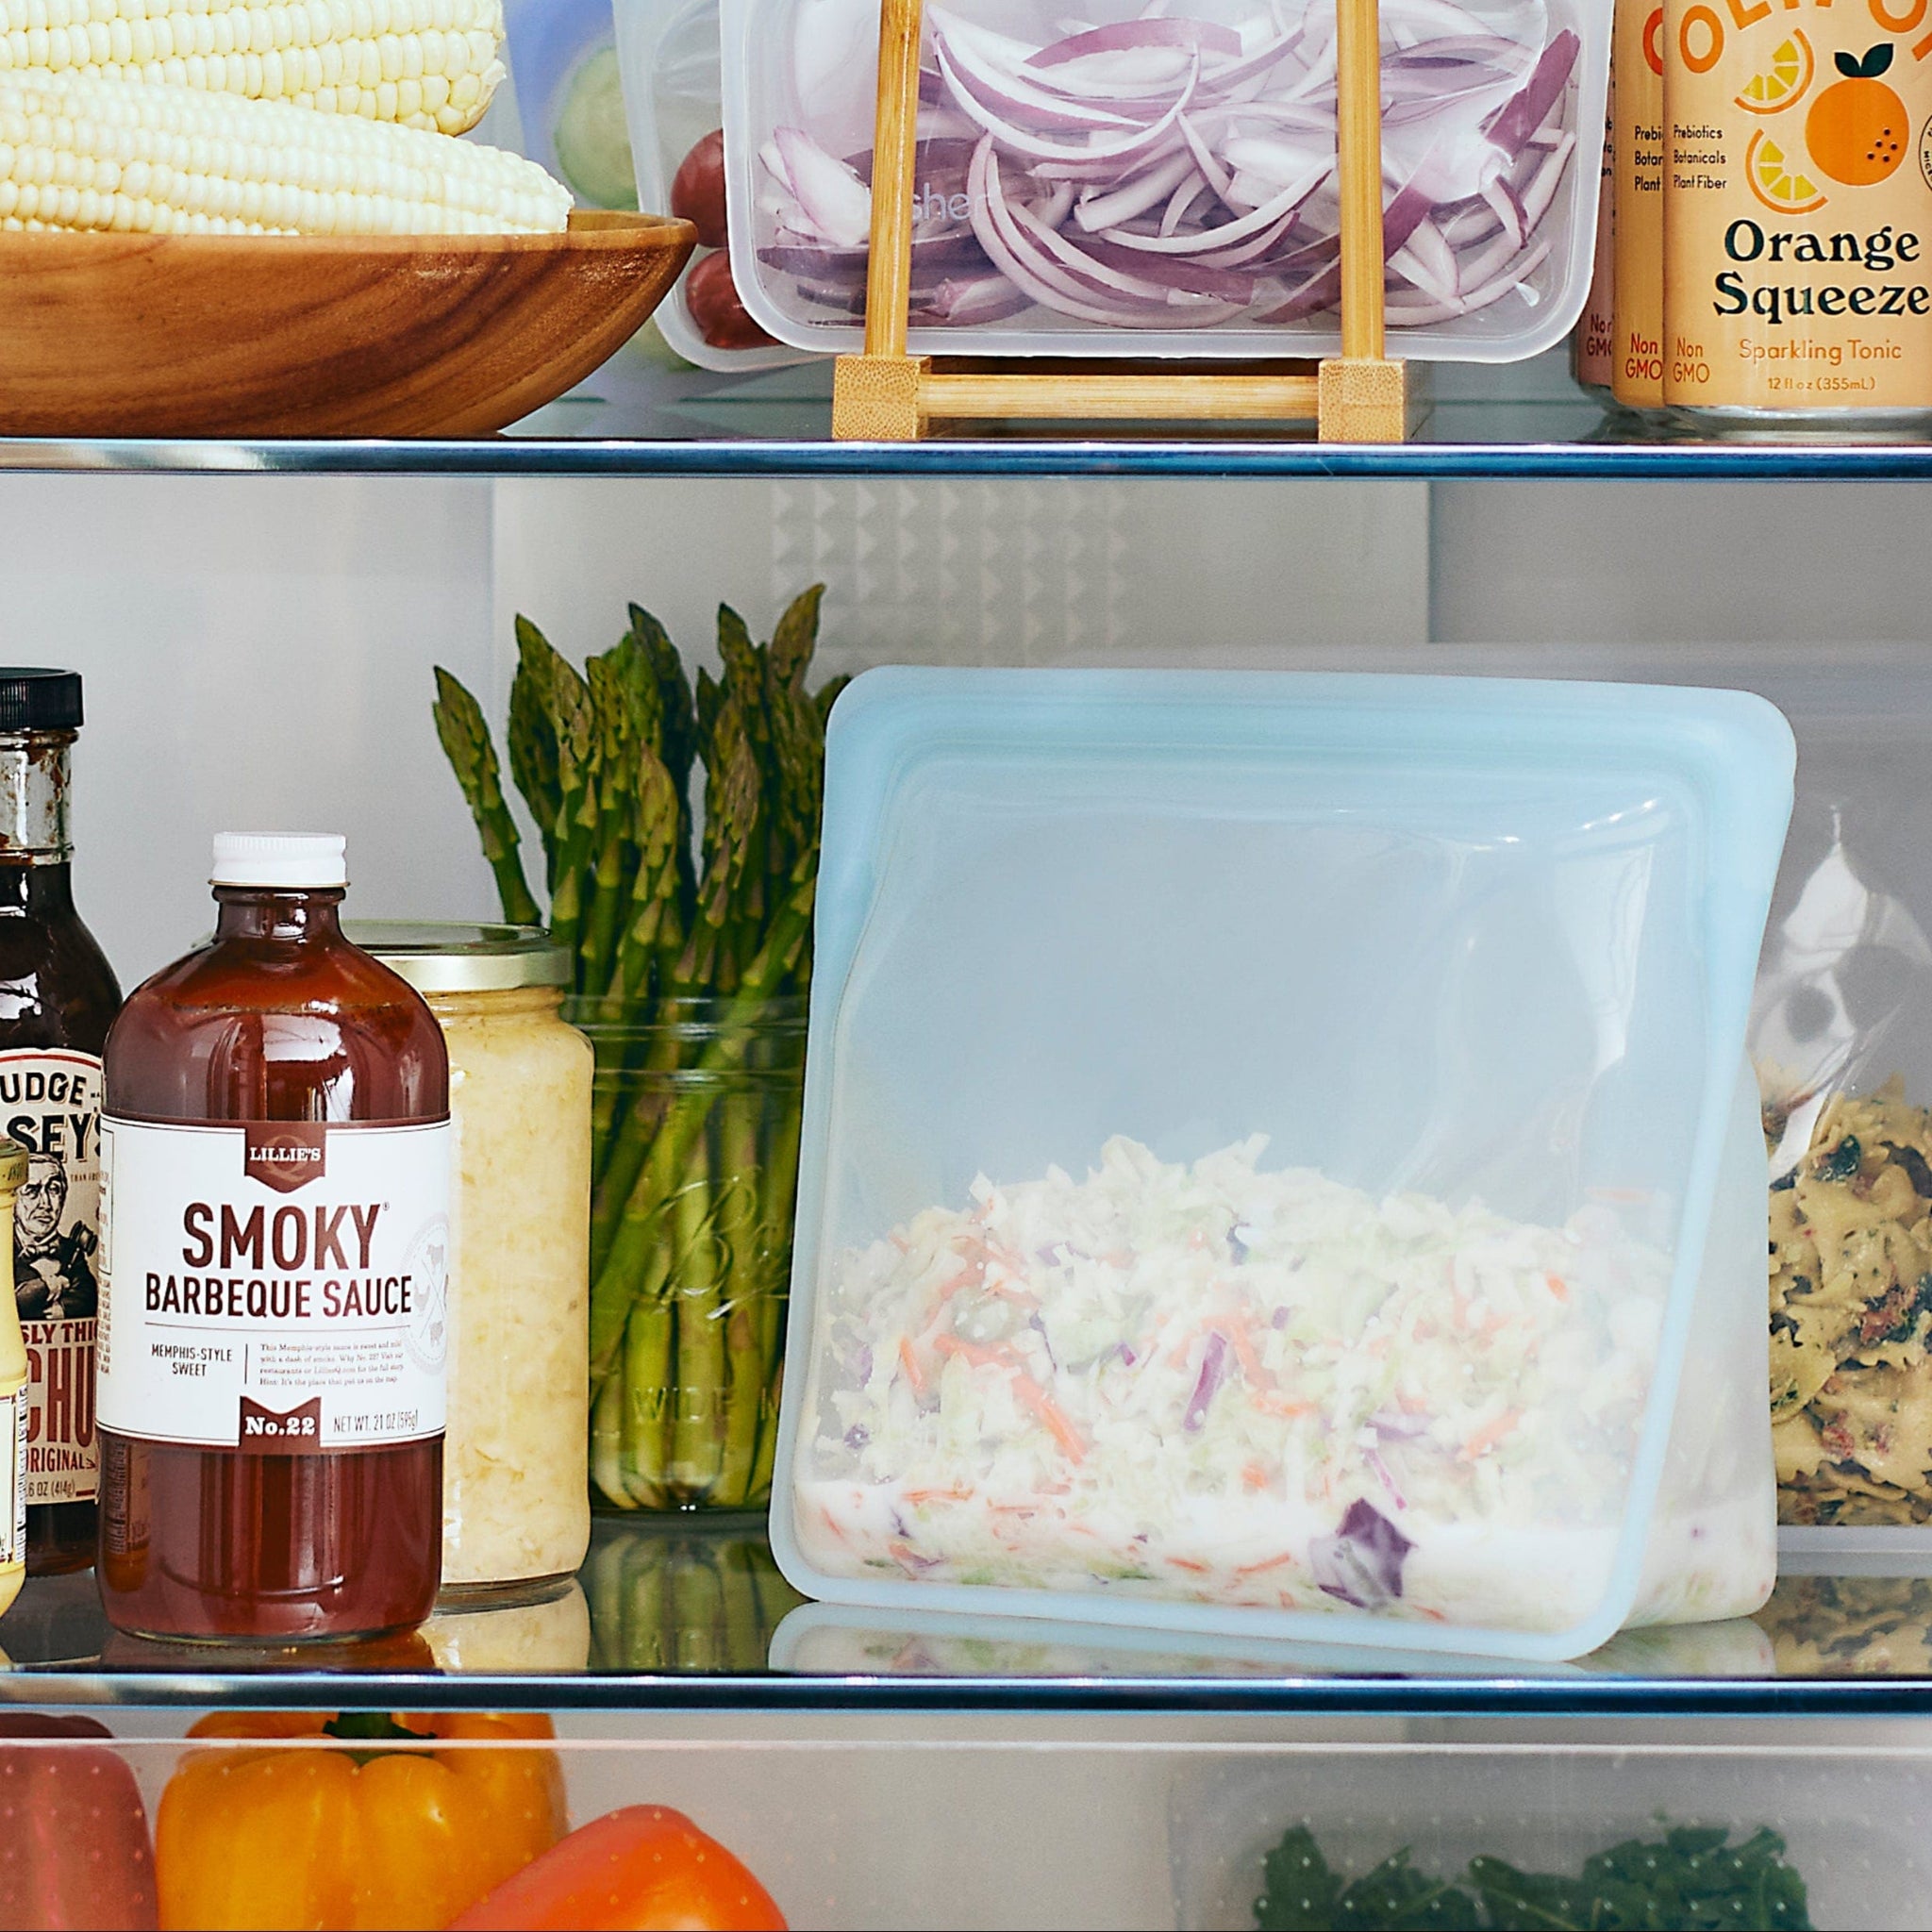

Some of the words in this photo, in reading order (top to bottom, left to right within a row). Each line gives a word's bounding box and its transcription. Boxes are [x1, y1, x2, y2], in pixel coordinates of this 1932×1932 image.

[1673, 124, 1724, 140] Prebiotics
[1673, 149, 1727, 164] Botanicals
[1634, 175, 1661, 192] Plant
[1673, 174, 1696, 189] Plant
[1696, 174, 1727, 189] Fiber
[1724, 219, 1921, 272] Orange
[1713, 270, 1930, 325] Squeeze
[1630, 332, 1658, 355] Non
[1676, 337, 1704, 358] Non
[1740, 338, 1841, 366] Sparkling
[1847, 339, 1902, 359] Tonic
[1624, 357, 1663, 380] GMO
[1673, 361, 1710, 384] GMO
[1768, 377, 1781, 391] 12
[1817, 376, 1875, 391] (355mL)
[250, 1146, 321, 1162] LILLIE'S
[146, 1273, 311, 1318] BARBEQUE
[324, 1275, 411, 1317] SAUCE
[151, 1343, 232, 1362] MEMPHIS-STYLE
[172, 1362, 207, 1376] SWEET
[333, 1416, 352, 1433] NET
[354, 1415, 372, 1432] WT.
[374, 1414, 384, 1431] 21
[386, 1413, 396, 1430] OZ
[37, 1481, 49, 1498] OZ
